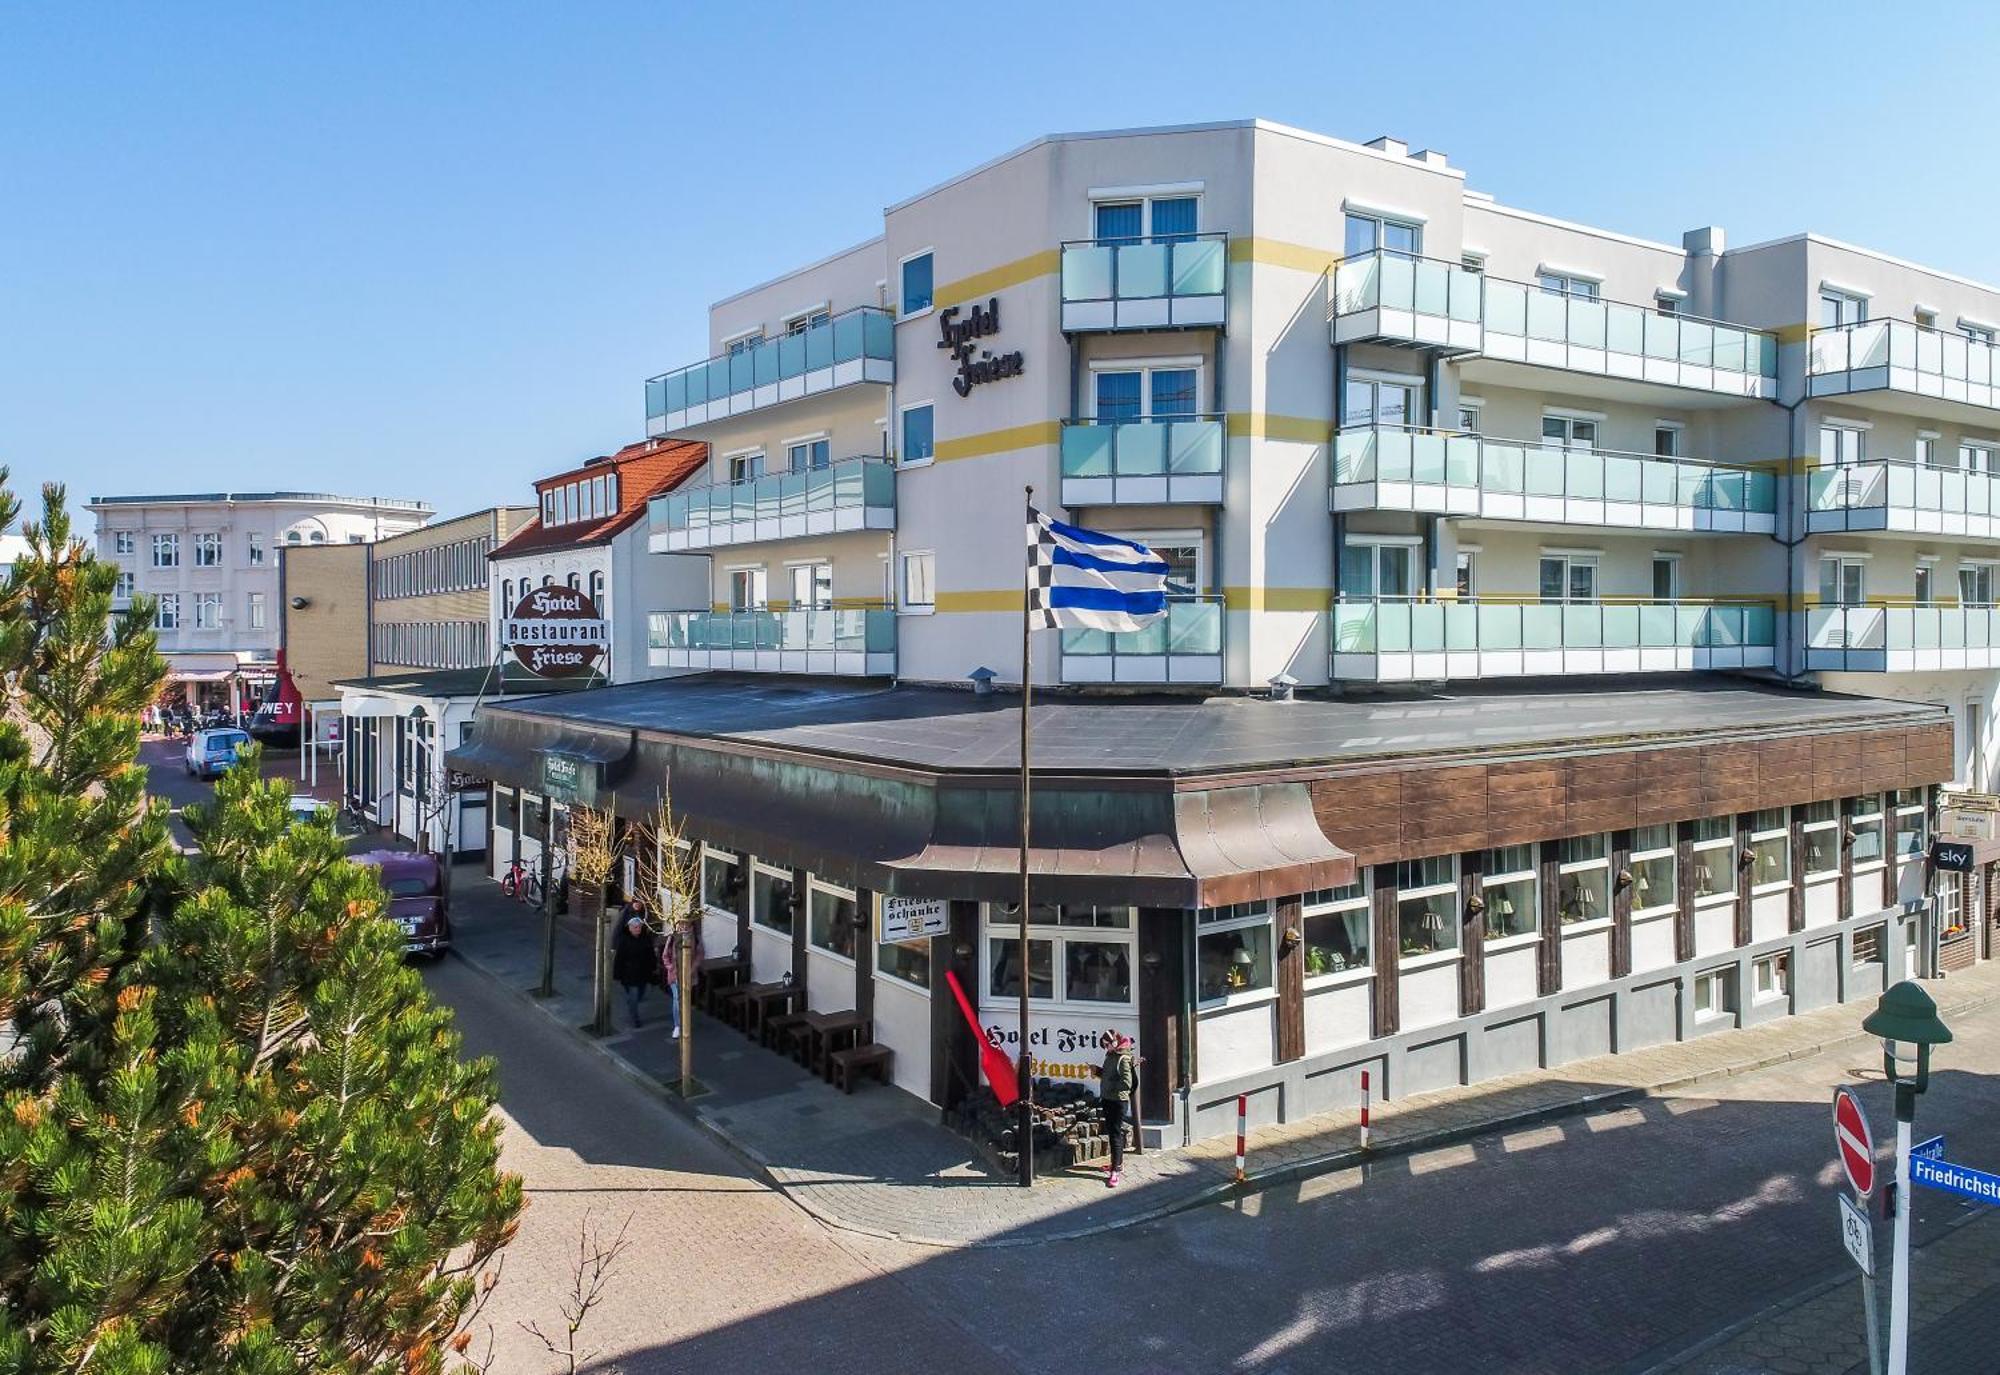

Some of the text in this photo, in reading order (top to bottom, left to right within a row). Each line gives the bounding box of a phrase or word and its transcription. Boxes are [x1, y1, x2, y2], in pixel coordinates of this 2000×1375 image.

[937, 297, 1000, 361] Hotel
[531, 591, 581, 616] Hotel
[509, 623, 606, 640] Restaurant
[532, 647, 584, 672] Friese
[1939, 849, 1967, 866] sky
[986, 1025, 1049, 1049] Hoel
